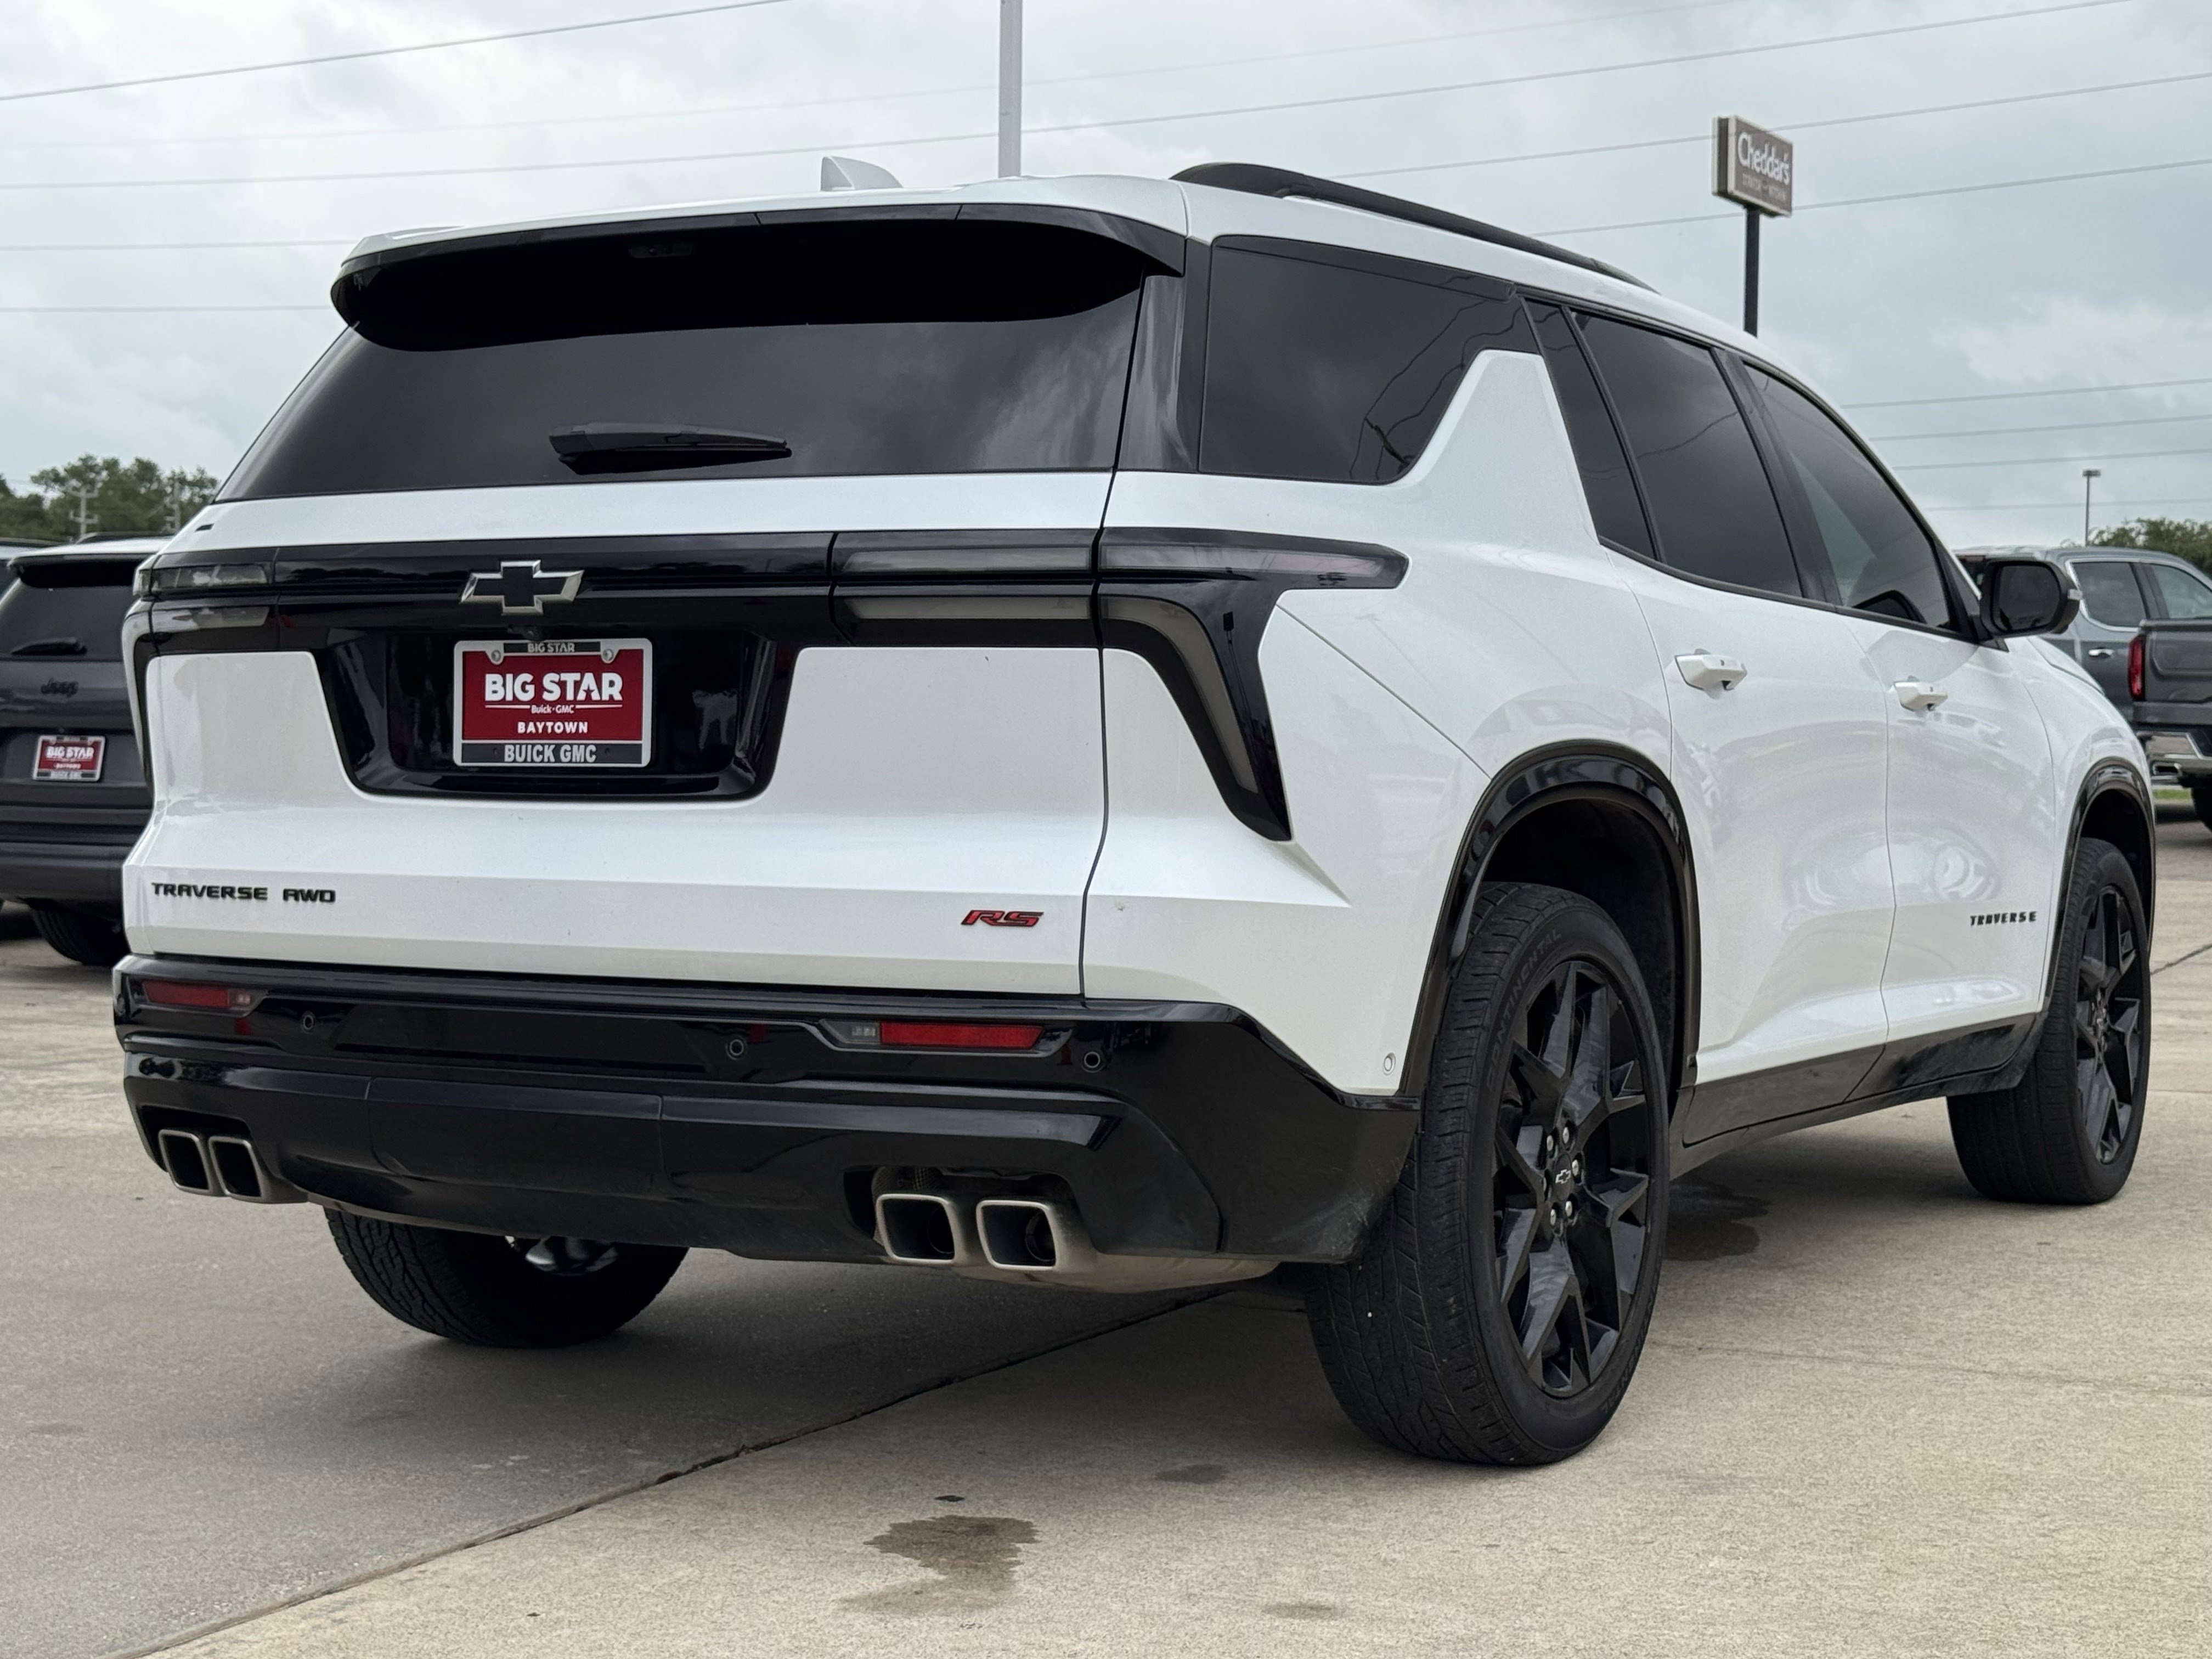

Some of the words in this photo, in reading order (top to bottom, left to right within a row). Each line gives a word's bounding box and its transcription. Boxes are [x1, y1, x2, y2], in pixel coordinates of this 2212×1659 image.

[528, 642, 545, 653] BIG
[548, 642, 575, 653] STAR
[484, 673, 535, 701] BIG
[542, 673, 623, 701] STAR
[517, 721, 588, 733] BAYTOWN
[504, 744, 555, 762] BUICK
[560, 744, 597, 762] GMC
[151, 882, 268, 901] TRAVERSE
[283, 888, 336, 903] AWD
[961, 910, 1044, 927] RS
[1970, 911, 2037, 926] TRAVERSE
